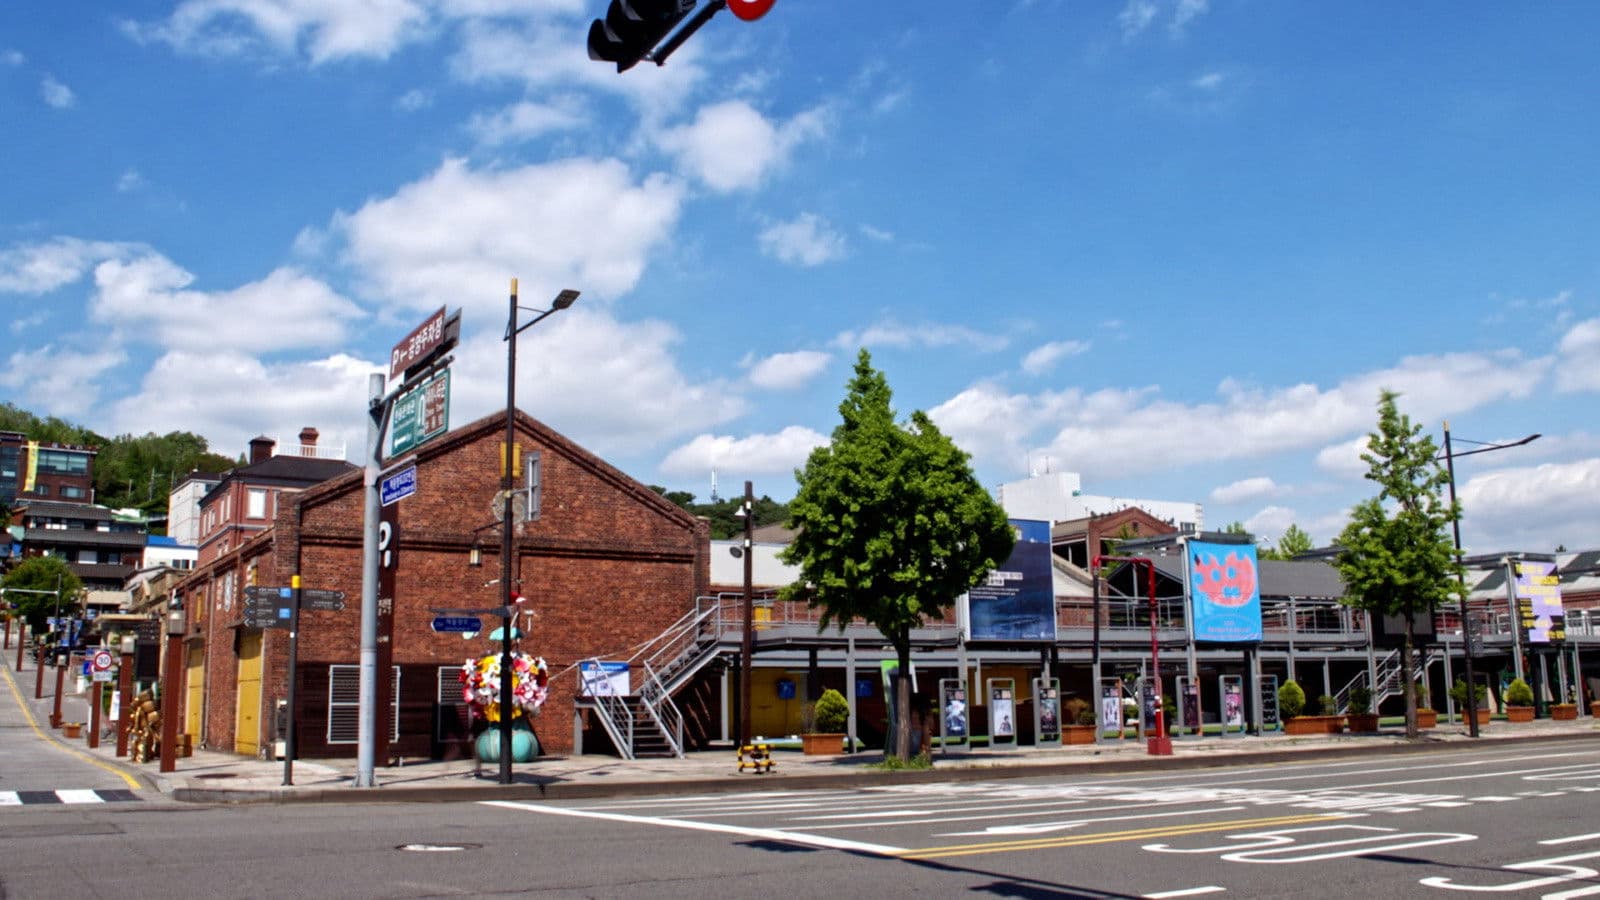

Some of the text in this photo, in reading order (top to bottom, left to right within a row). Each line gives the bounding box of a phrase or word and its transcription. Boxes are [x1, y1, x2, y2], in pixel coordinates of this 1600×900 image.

[392, 314, 444, 374] P 공영주차장
[98, 656, 110, 665] 30
[1141, 824, 1479, 864] 50
